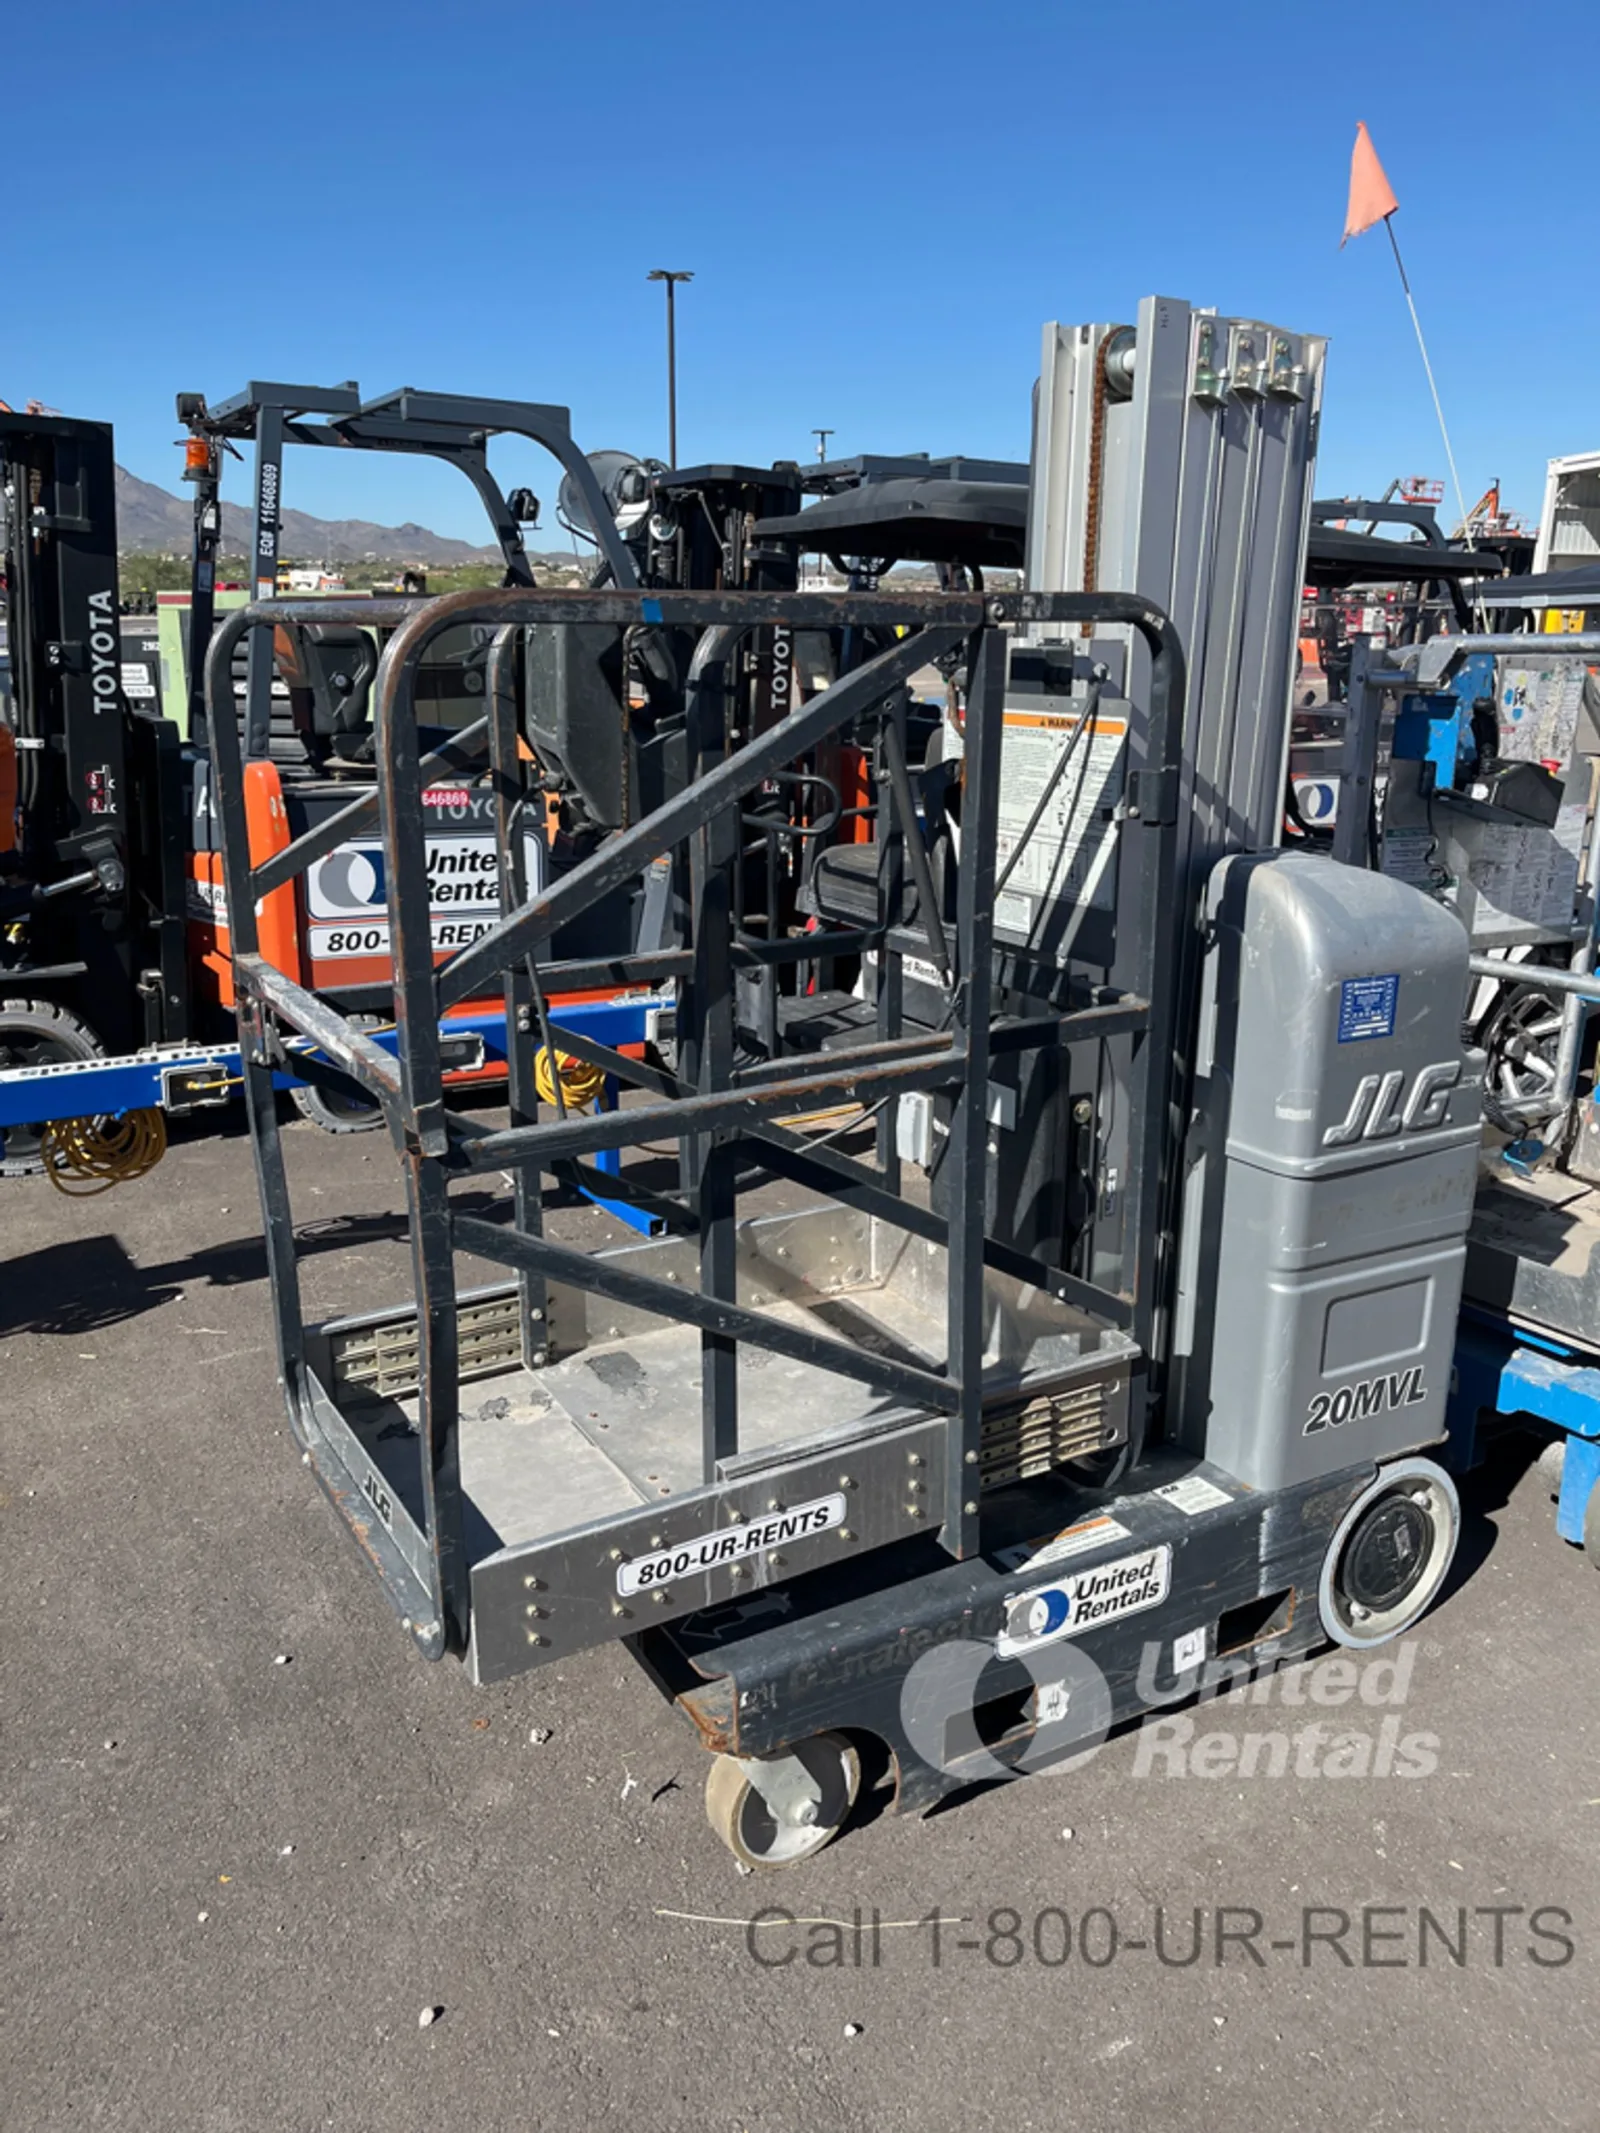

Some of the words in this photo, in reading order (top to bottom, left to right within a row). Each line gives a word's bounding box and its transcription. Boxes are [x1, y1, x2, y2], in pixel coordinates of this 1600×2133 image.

[87, 590, 118, 714] TOYOTA
[770, 625, 791, 709] TOYOT
[435, 797, 537, 821] TOYOA
[427, 847, 497, 874] nite
[427, 877, 500, 903] enta
[1322, 1060, 1462, 1148] JLG
[1302, 1365, 1428, 1437] 20MVL
[364, 1473, 391, 1524] JLG
[637, 1506, 829, 1585] 800-UR-RENTS
[1074, 1580, 1161, 1625] Rentals
[1076, 1556, 1157, 1601] United
